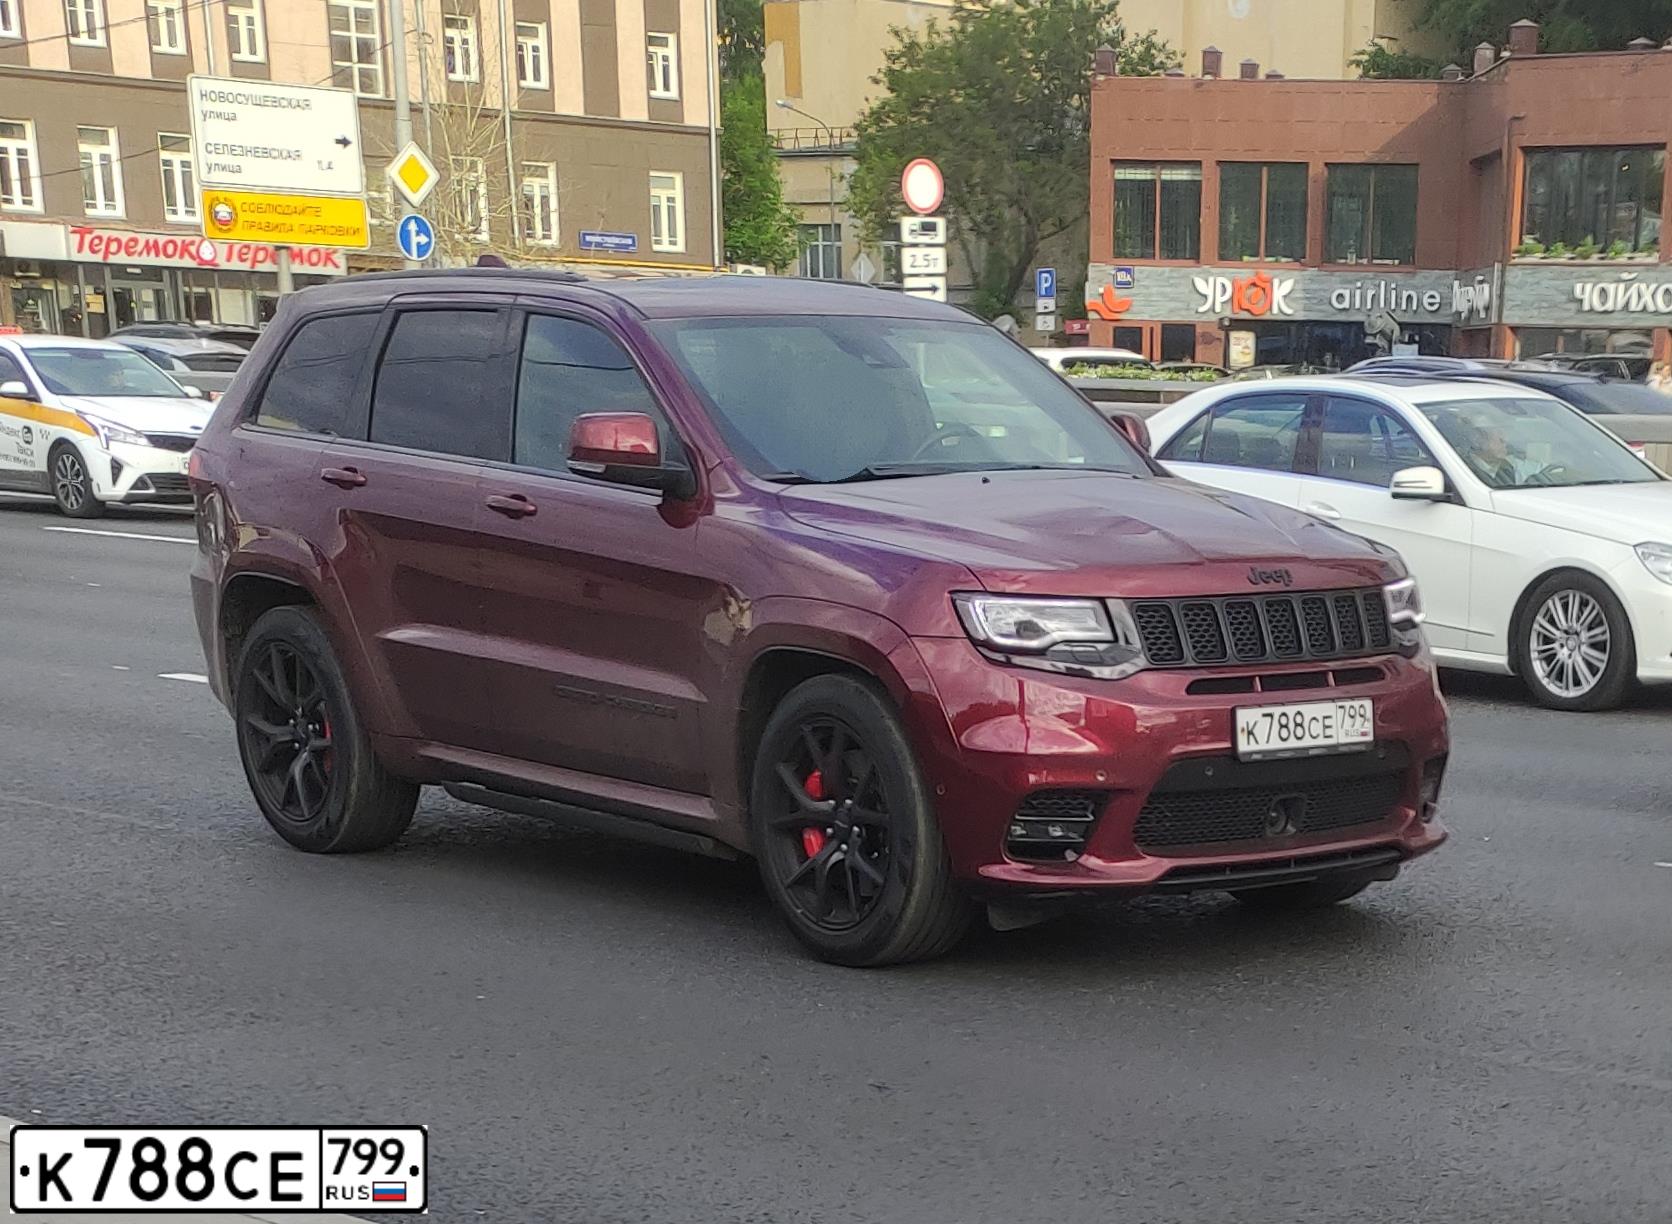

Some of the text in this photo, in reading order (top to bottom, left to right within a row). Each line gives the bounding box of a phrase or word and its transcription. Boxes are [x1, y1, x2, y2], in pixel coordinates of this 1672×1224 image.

[200, 89, 312, 110] НОВОСУЩЕВСКАЯ
[201, 109, 237, 122] улица
[206, 161, 242, 175] улица
[242, 220, 294, 233] ПРАВИЛА
[70, 227, 199, 263] Теремок
[1192, 271, 1295, 316] УРЮК
[1330, 280, 1442, 313] airline
[1247, 567, 1293, 587] Jeep
[1337, 704, 1367, 729] 799
